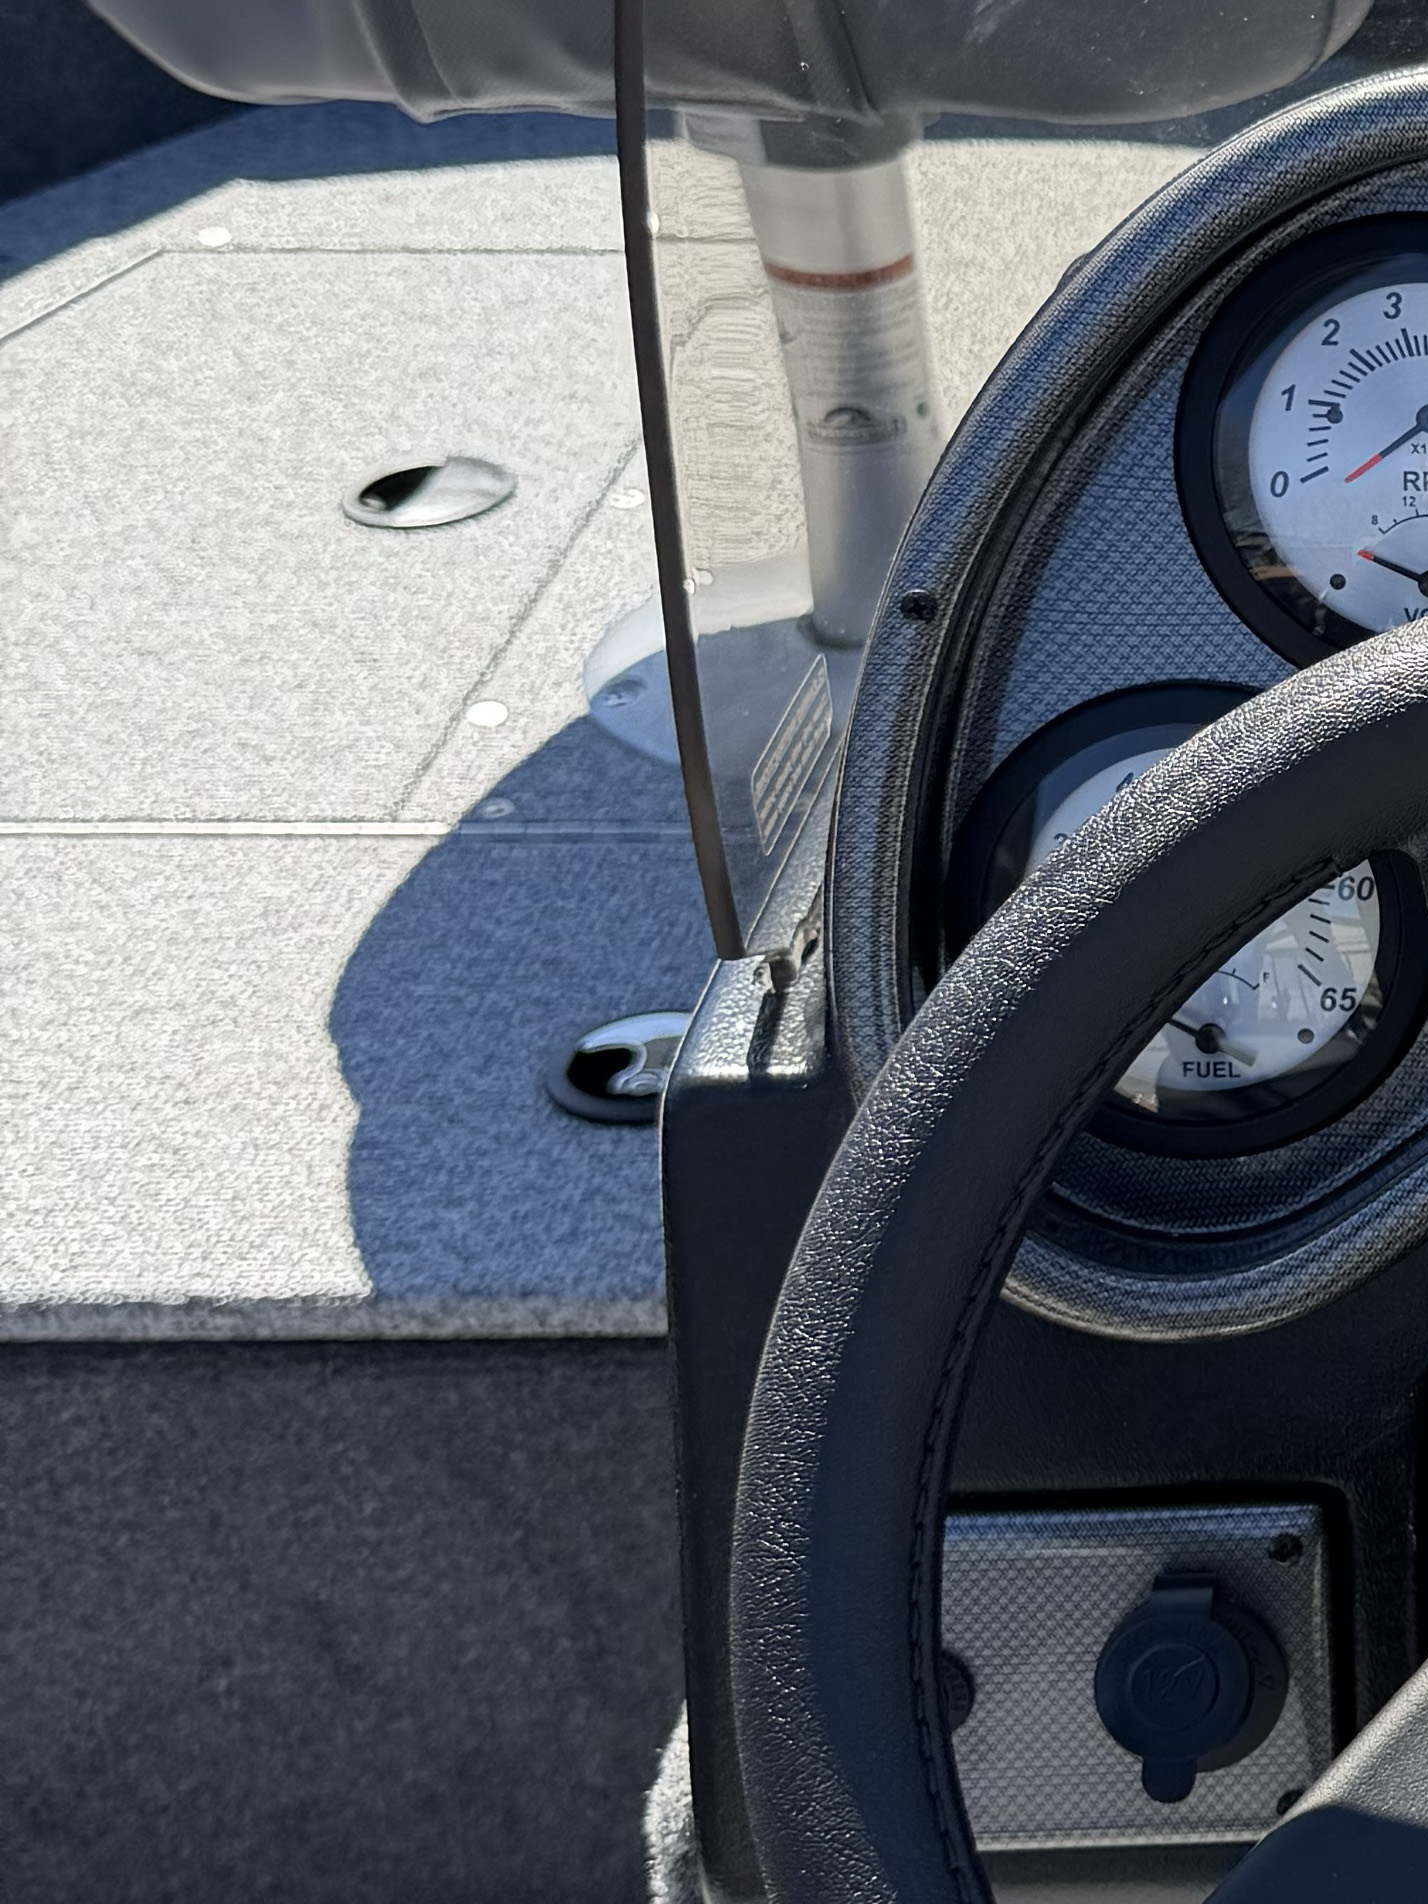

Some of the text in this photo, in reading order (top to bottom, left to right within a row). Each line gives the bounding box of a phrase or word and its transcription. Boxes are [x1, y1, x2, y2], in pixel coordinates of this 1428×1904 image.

[1383, 291, 1402, 320] 3
[1321, 319, 1340, 346] 2
[1280, 383, 1297, 412] 1
[1269, 470, 1289, 498] 0
[1402, 496, 1417, 508] 12
[1338, 876, 1375, 901] 60
[1320, 987, 1357, 1012] 65
[1182, 1061, 1241, 1079] FUEL
